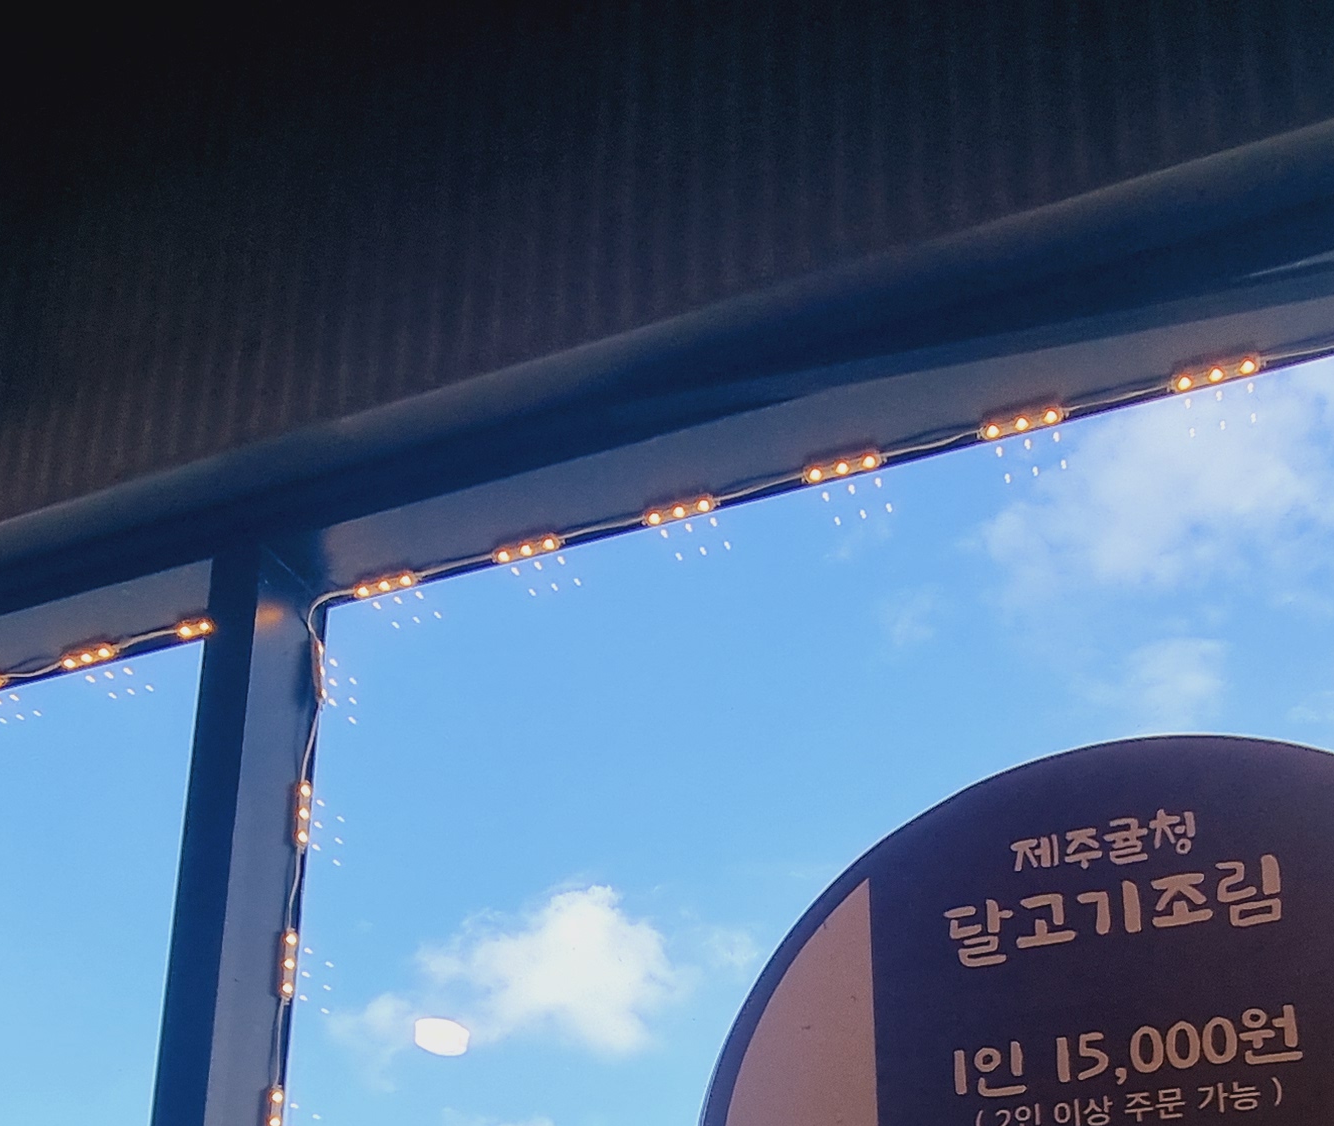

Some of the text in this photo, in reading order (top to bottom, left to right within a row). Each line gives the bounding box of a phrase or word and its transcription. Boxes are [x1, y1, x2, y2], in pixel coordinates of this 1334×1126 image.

[1010, 808, 1197, 873] 제주귤청
[942, 853, 1283, 968] 달고기조림
[952, 1004, 1304, 1098] 1인 15,000원
[1123, 1087, 1187, 1123] 주문
